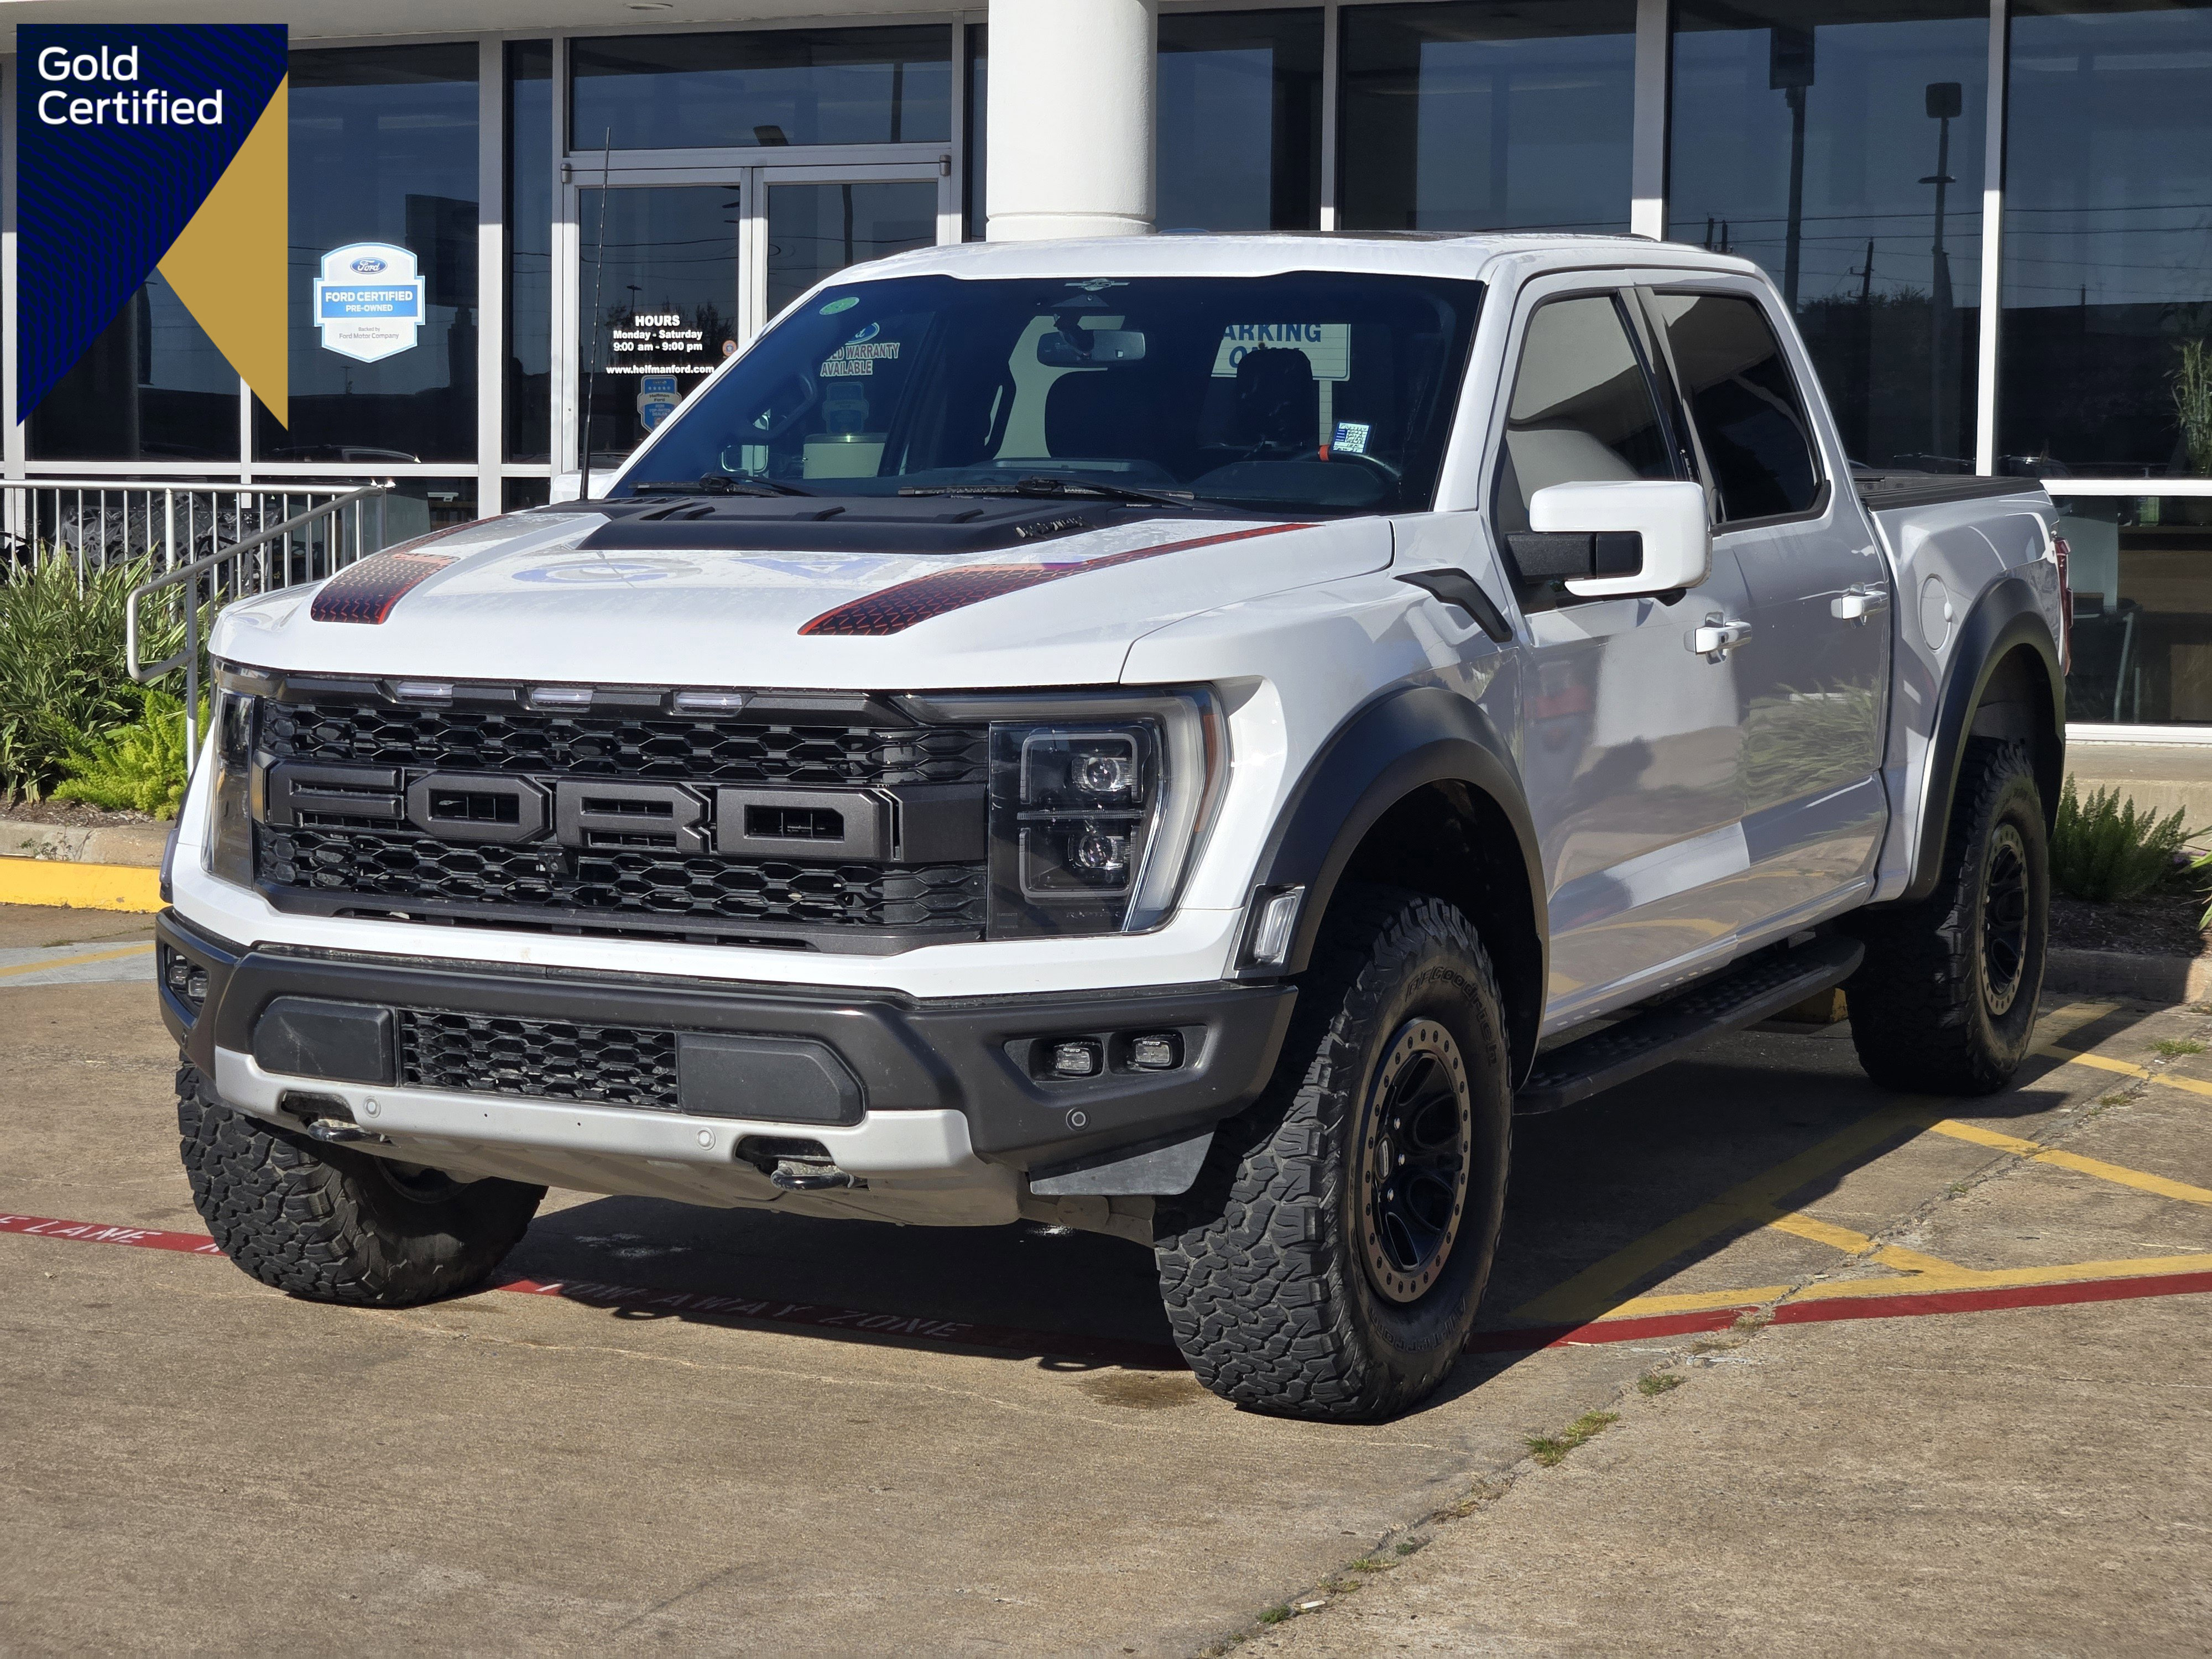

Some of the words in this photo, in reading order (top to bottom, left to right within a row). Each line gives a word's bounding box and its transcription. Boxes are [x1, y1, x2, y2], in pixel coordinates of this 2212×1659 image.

[357, 259, 381, 272] Ford
[325, 291, 355, 302] FORD
[357, 291, 413, 301] CERTIFIED
[635, 315, 680, 326] HOURS
[613, 330, 651, 341] Monday
[659, 330, 703, 340] Saturday
[1223, 325, 1321, 342] ARKING
[613, 342, 634, 351] 9:00
[662, 342, 684, 351] 9:00
[686, 343, 703, 352] pm
[846, 343, 900, 359] WARRANTY
[606, 364, 715, 374] www.helfmanford.com
[821, 361, 873, 376] AVAILABLE
[267, 760, 893, 861] FORD
[24, 1220, 164, 1244] LANE
[648, 1293, 815, 1318] AWAY
[818, 1310, 974, 1337] ZONE
